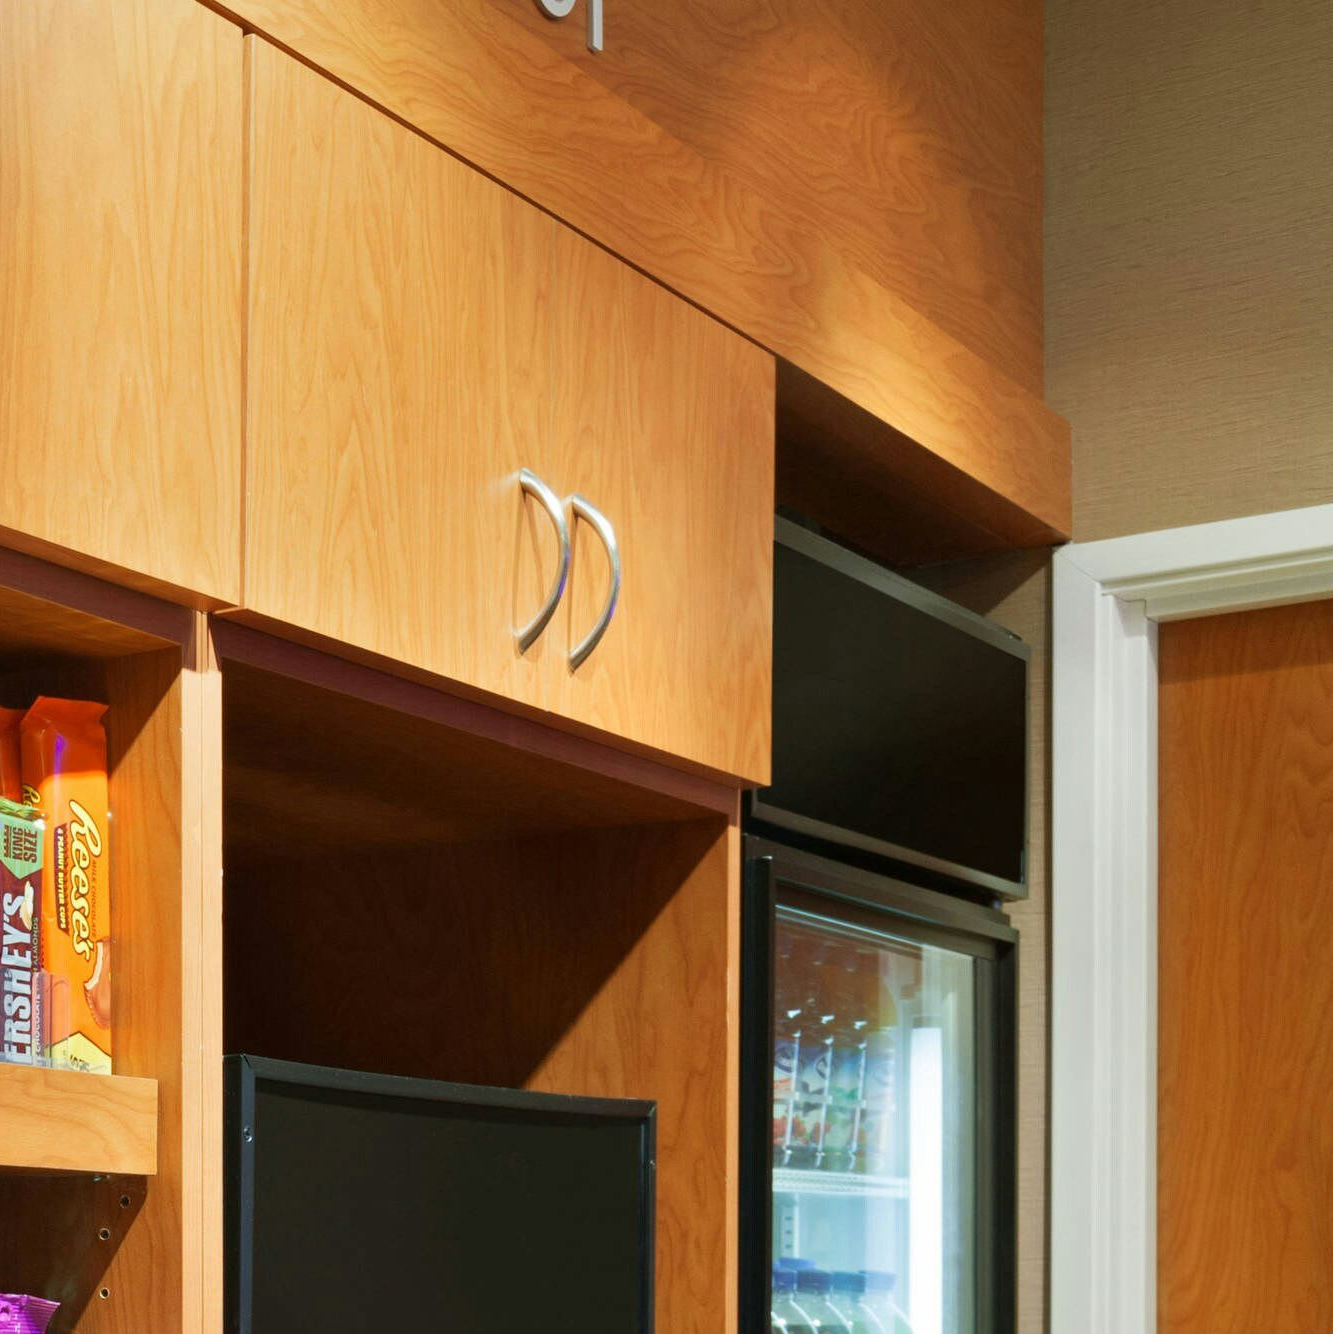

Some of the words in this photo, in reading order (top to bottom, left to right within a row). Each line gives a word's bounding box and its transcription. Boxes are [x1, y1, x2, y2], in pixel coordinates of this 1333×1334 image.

[13, 825, 24, 861] KING
[23, 828, 38, 864] SIZE
[70, 800, 103, 962] Reese's
[59, 907, 67, 929] CUPS
[1, 892, 33, 1064] ERSHEY'S
